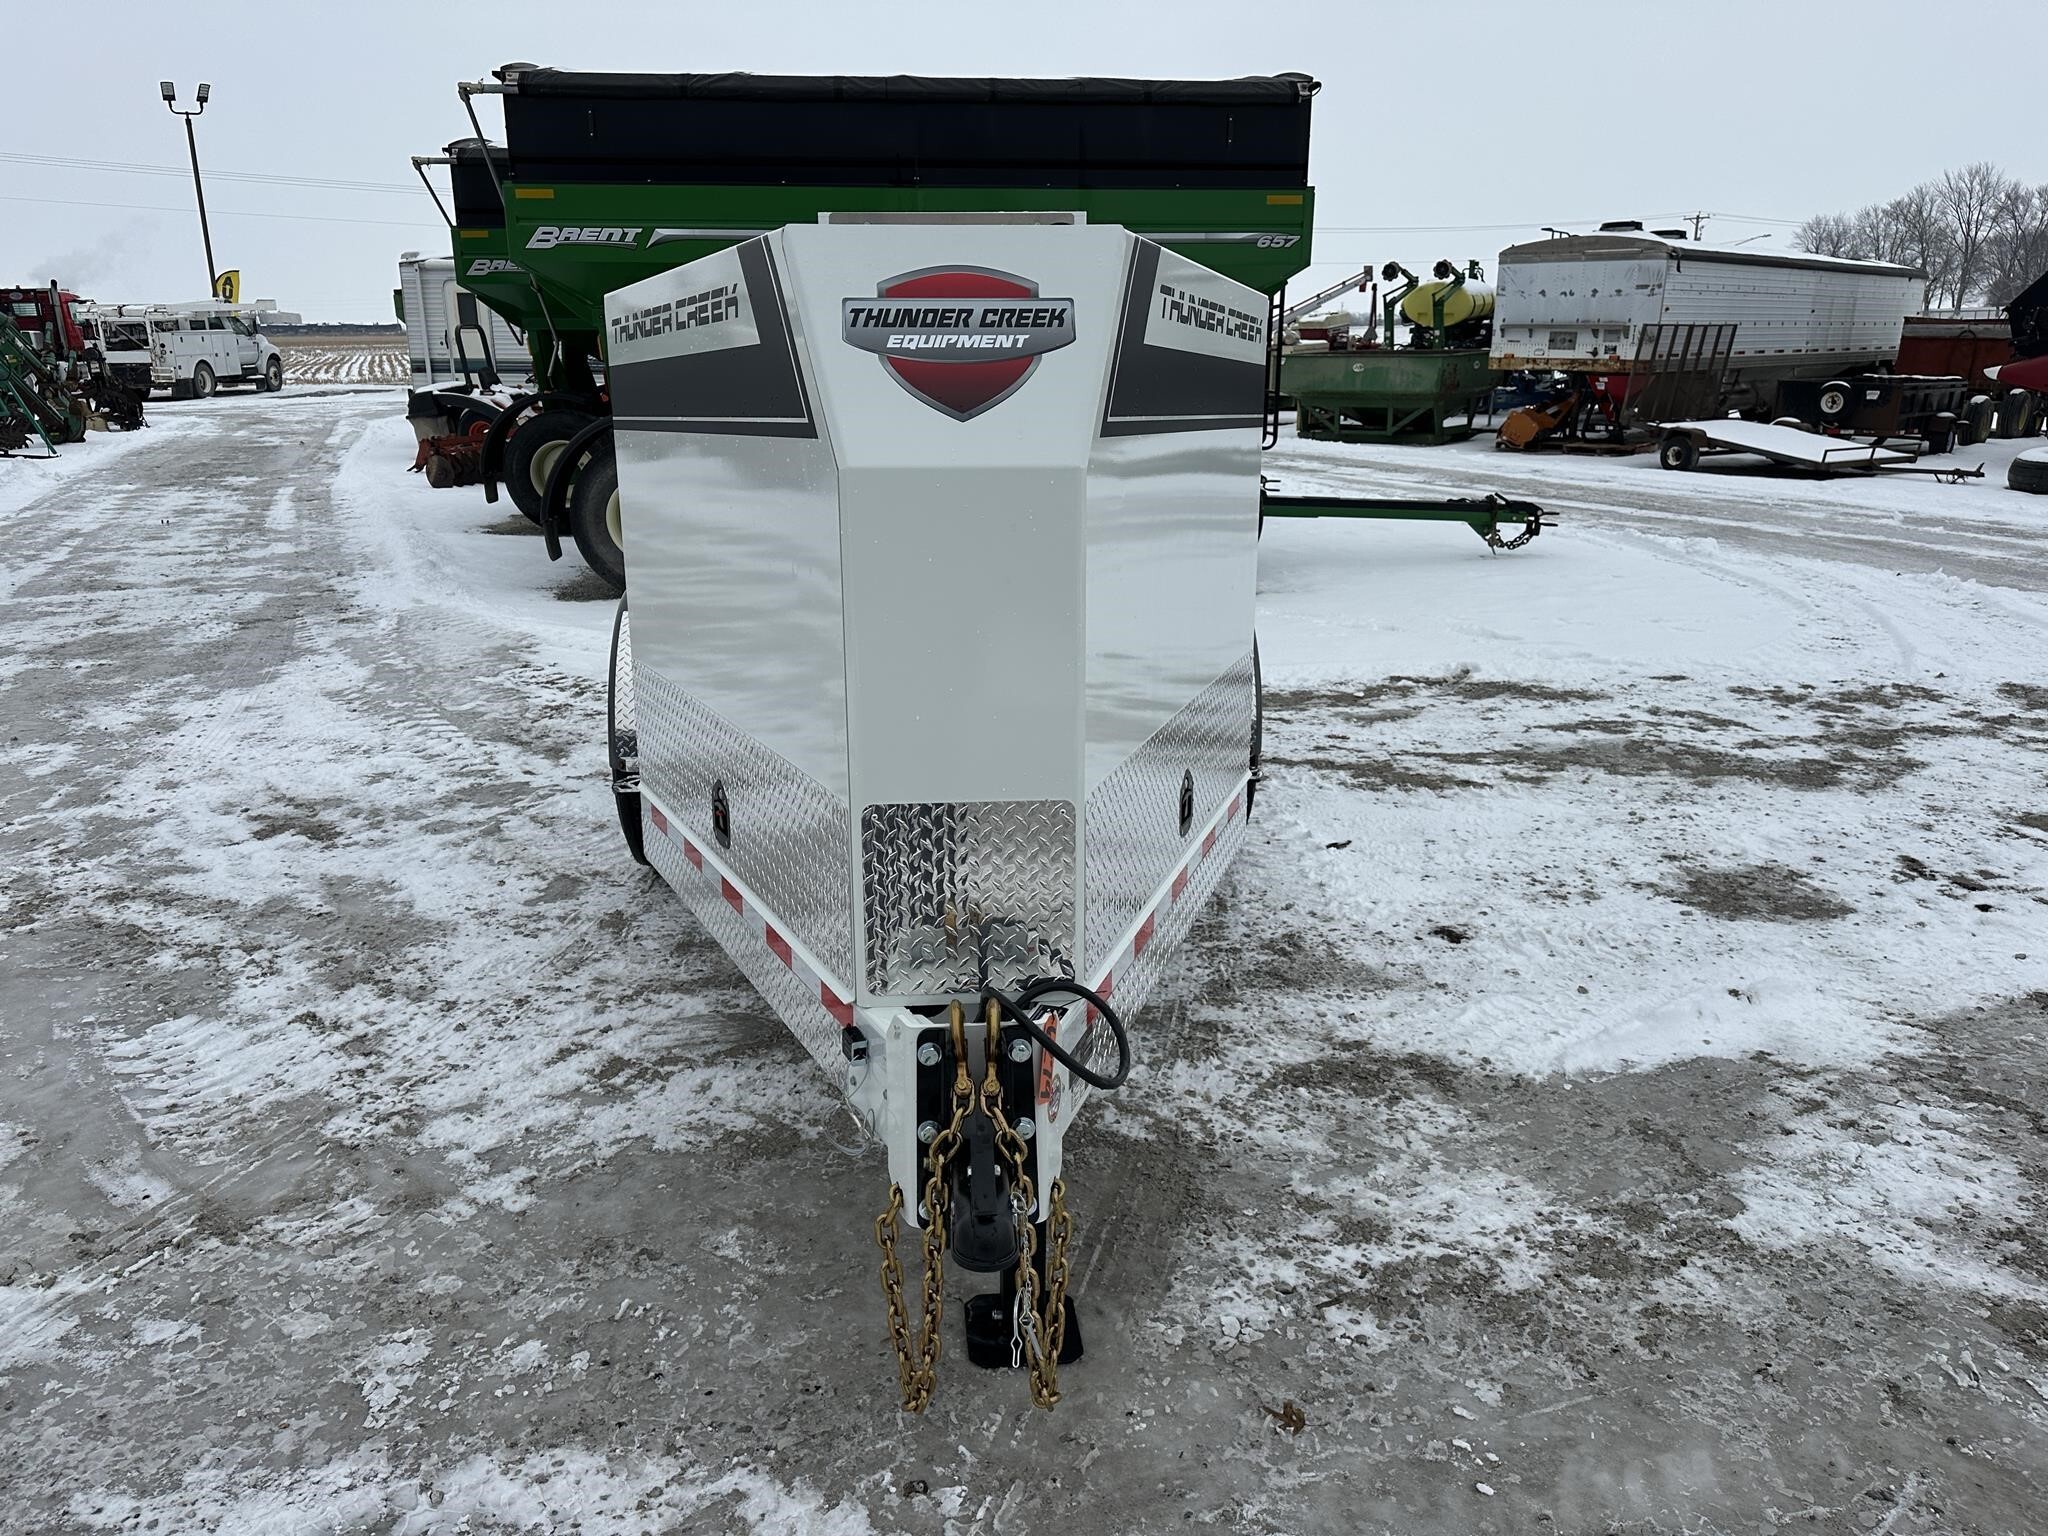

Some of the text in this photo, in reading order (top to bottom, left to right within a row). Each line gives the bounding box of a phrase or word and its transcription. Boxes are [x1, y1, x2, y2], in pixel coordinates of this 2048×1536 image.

[525, 226, 643, 249] BRENT
[1256, 236, 1300, 248] 657
[611, 283, 739, 344] THUNDER CREEK
[849, 308, 1068, 328] THUNDER CREEK
[1160, 284, 1263, 344] THUNDER CREEK
[886, 334, 1031, 350] EQUIPMENT
